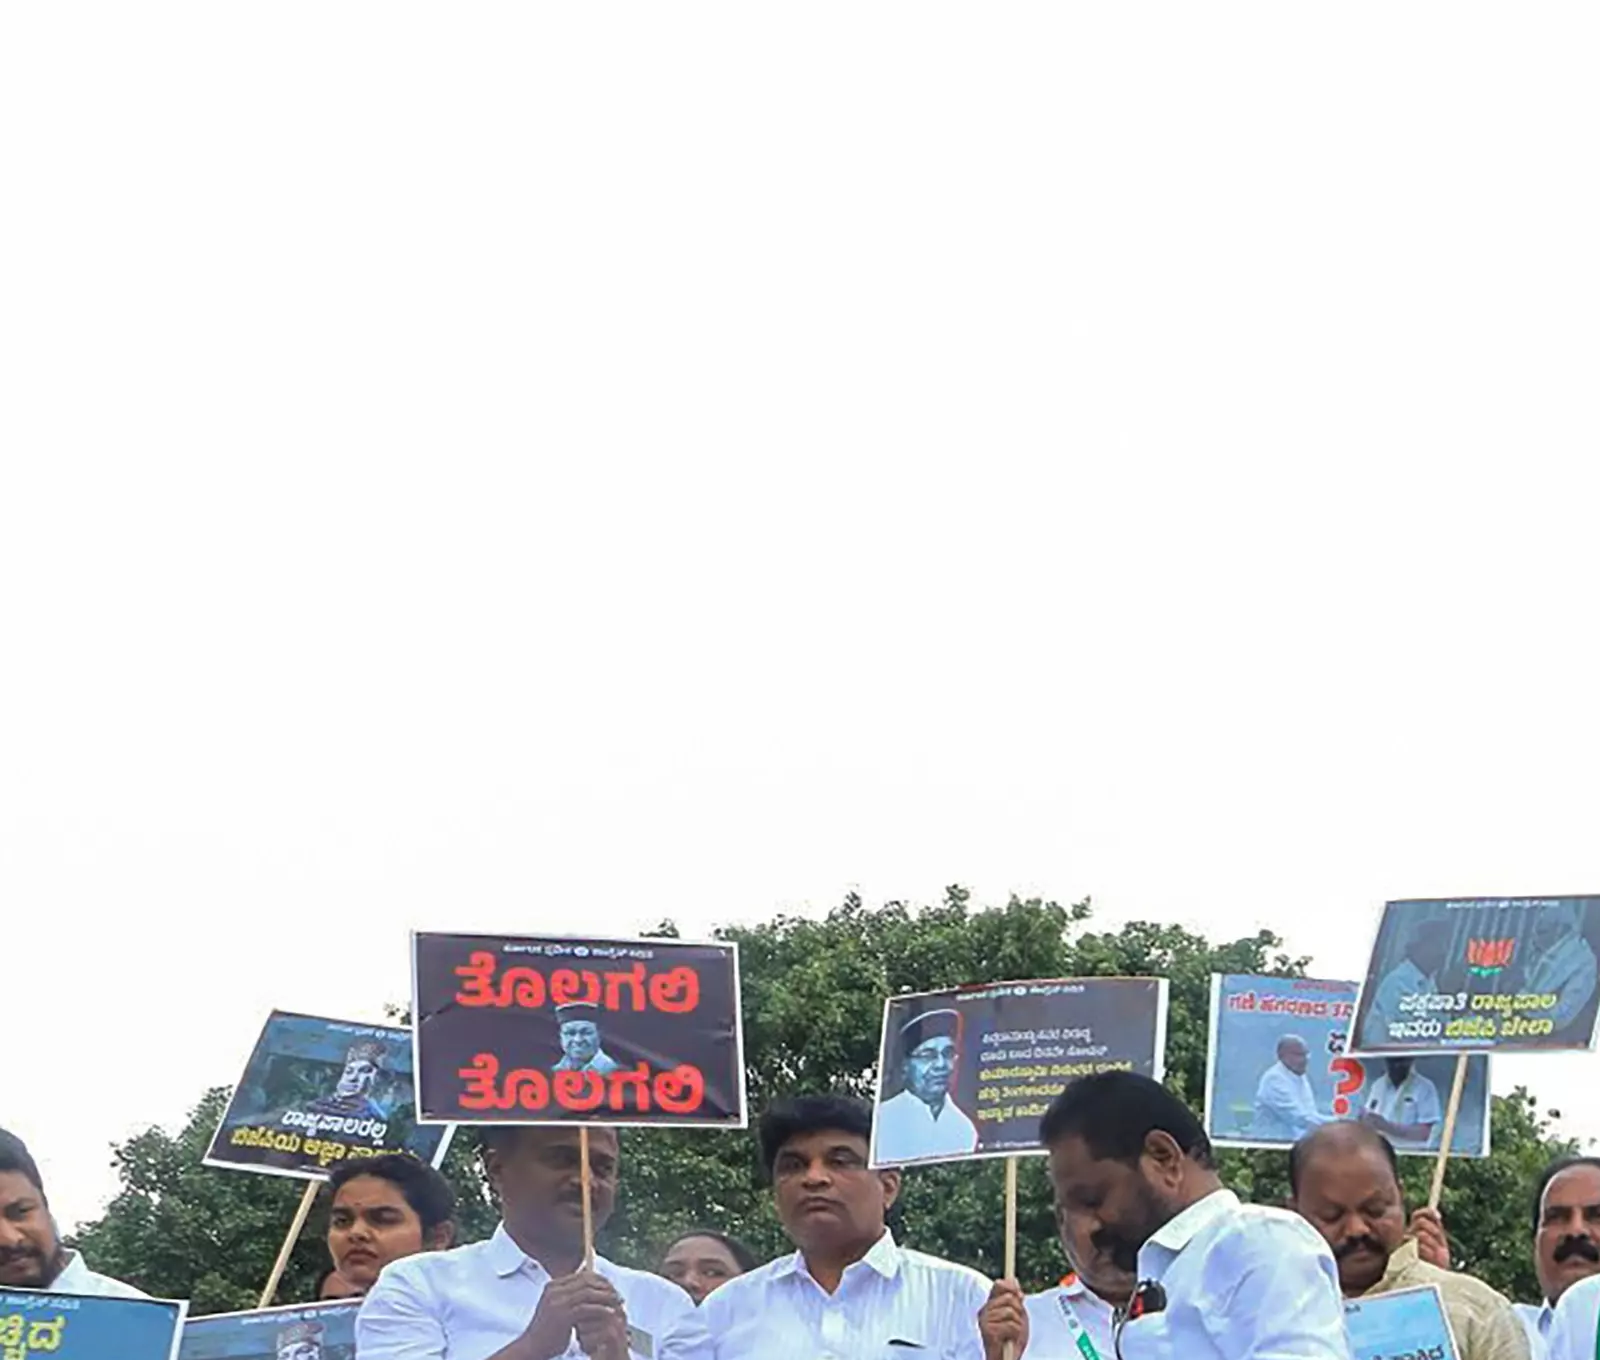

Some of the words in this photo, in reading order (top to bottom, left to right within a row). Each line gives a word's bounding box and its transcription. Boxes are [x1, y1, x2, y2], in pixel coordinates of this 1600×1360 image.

[454, 951, 700, 1013] ತೊಲಗಲಿ
[1470, 992, 1557, 1019] ರಾಜ್ಯಪಾಲ
[458, 1053, 705, 1114] ತೊಲಗಲಿ
[1328, 1057, 1366, 1118] ?
